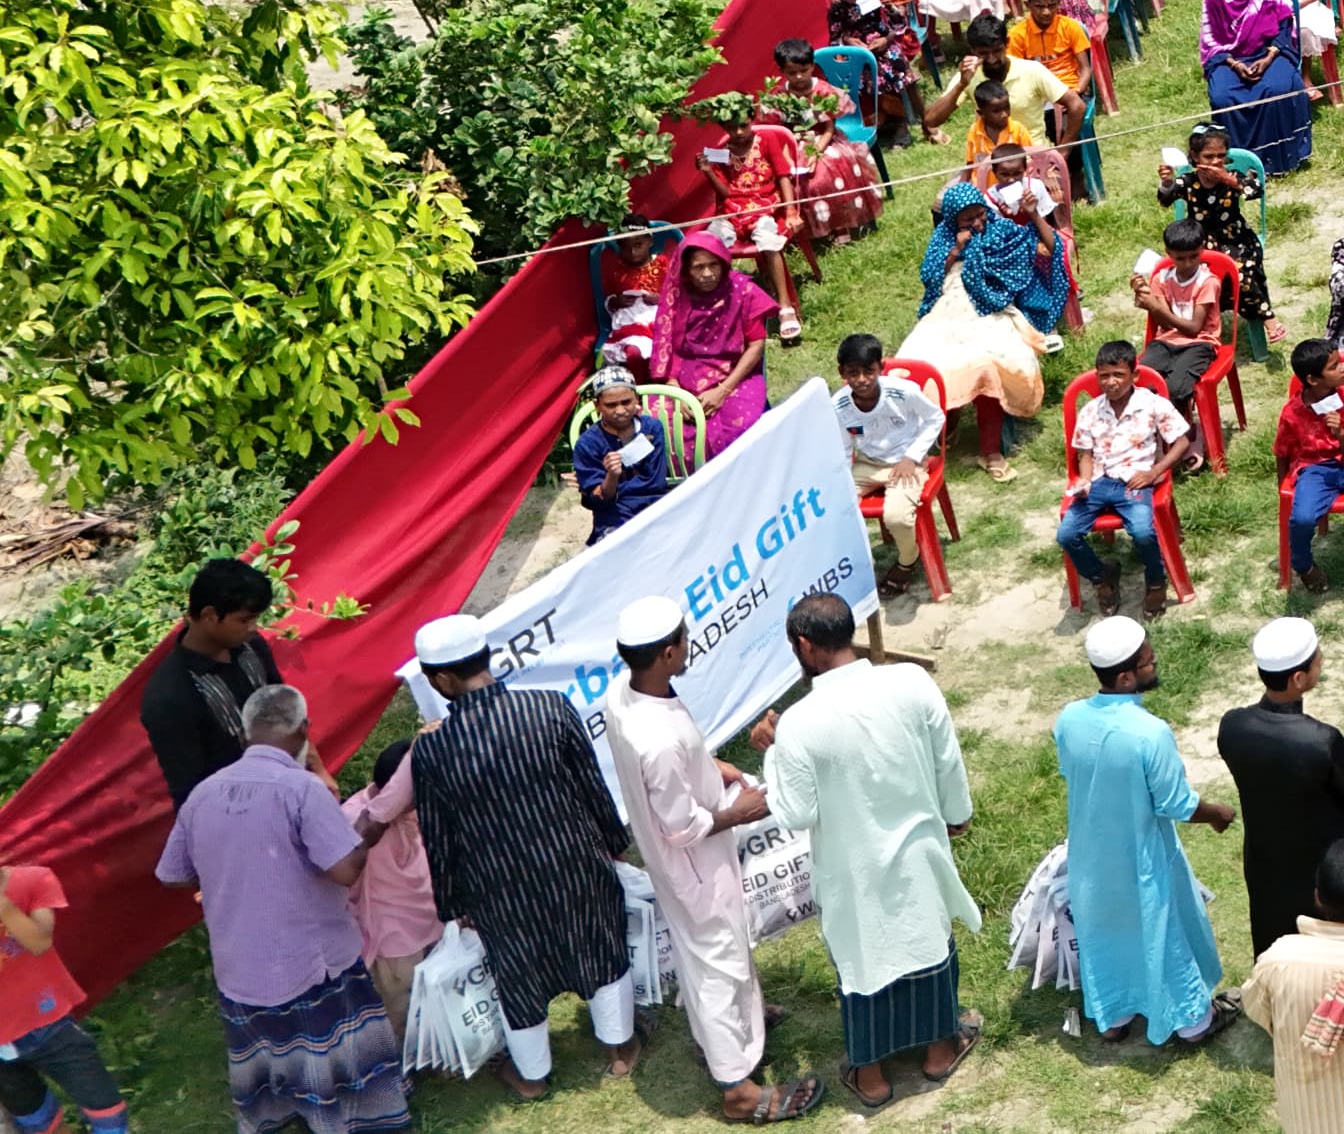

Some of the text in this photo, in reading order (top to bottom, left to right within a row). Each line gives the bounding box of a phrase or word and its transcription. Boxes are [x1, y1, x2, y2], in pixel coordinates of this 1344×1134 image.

[684, 486, 826, 623] Eid Gift
[802, 557, 854, 599] WBS
[490, 608, 557, 682] GRT
[742, 871, 768, 893] EID
[749, 871, 810, 905] DISTRIBUTIO
[462, 999, 489, 1026] EID
